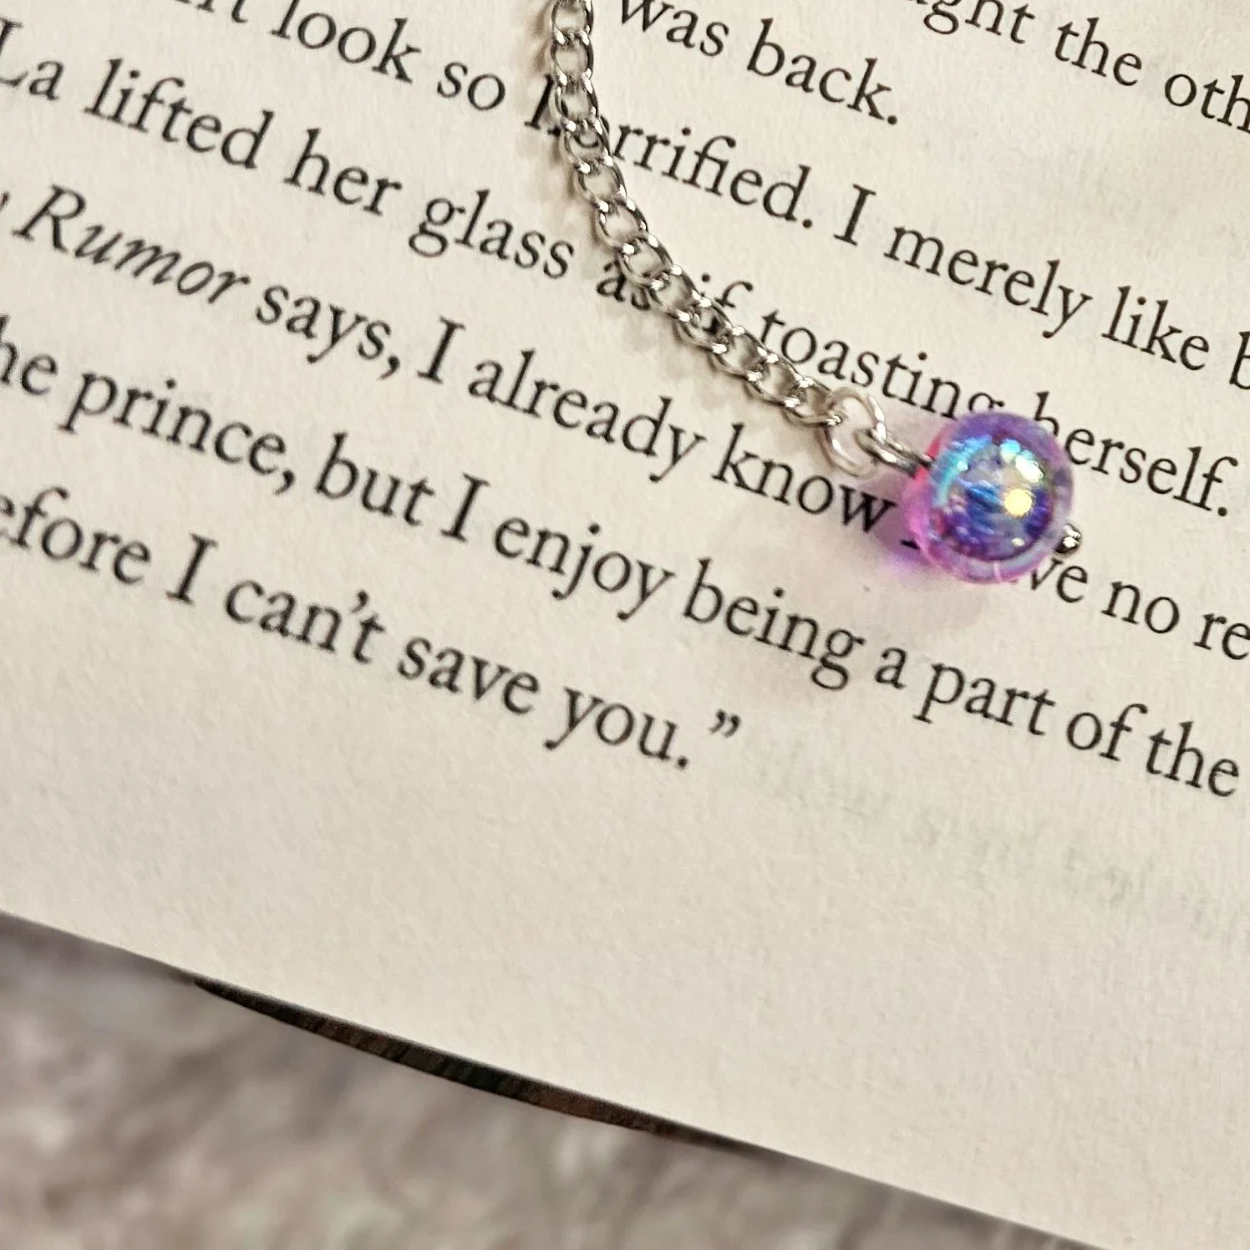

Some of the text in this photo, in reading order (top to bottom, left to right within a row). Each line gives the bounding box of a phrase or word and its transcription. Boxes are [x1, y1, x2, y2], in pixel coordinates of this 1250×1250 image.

[83, 58, 275, 169] lifted
[283, 128, 403, 216] her
[408, 190, 576, 280] glass
[747, 18, 898, 125] back.
[1055, 17, 1142, 86] the
[436, 62, 506, 111] so
[833, 184, 876, 246] I
[883, 226, 1093, 339] merely
[1101, 286, 1209, 371] like
[11, 184, 251, 304] Rumor
[255, 285, 400, 380] says,
[417, 316, 466, 384] I
[468, 348, 706, 483] already
[711, 422, 899, 533] know
[1101, 581, 1180, 634] no
[57, 372, 296, 496] prince,
[314, 432, 435, 527] but
[440, 473, 490, 543] I
[493, 517, 676, 622] enjoy
[682, 557, 866, 692] being
[874, 647, 908, 690] a
[913, 663, 1056, 736] part
[1066, 703, 1148, 762] of
[1146, 721, 1239, 797] the
[166, 533, 741, 770] I can’t save you.”
